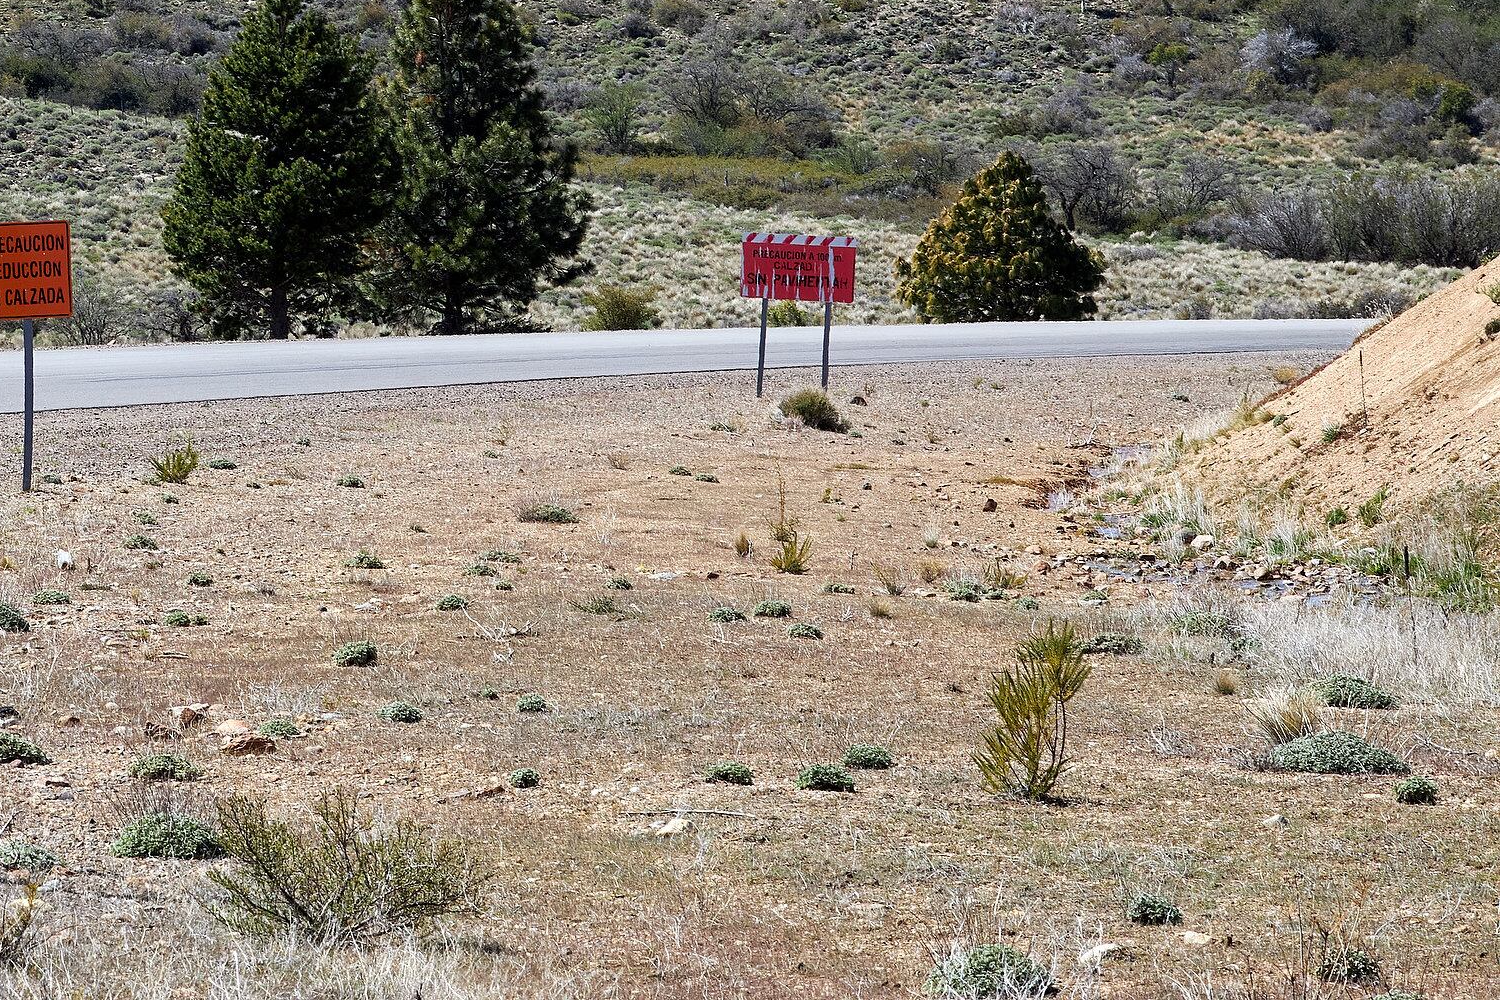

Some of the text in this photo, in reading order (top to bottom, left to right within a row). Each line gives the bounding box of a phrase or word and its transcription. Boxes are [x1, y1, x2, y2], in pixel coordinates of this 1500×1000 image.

[752, 249, 806, 260] PRECAUCION
[808, 252, 815, 261] A
[747, 272, 767, 286] SIN
[5, 287, 65, 306] CALZADA
